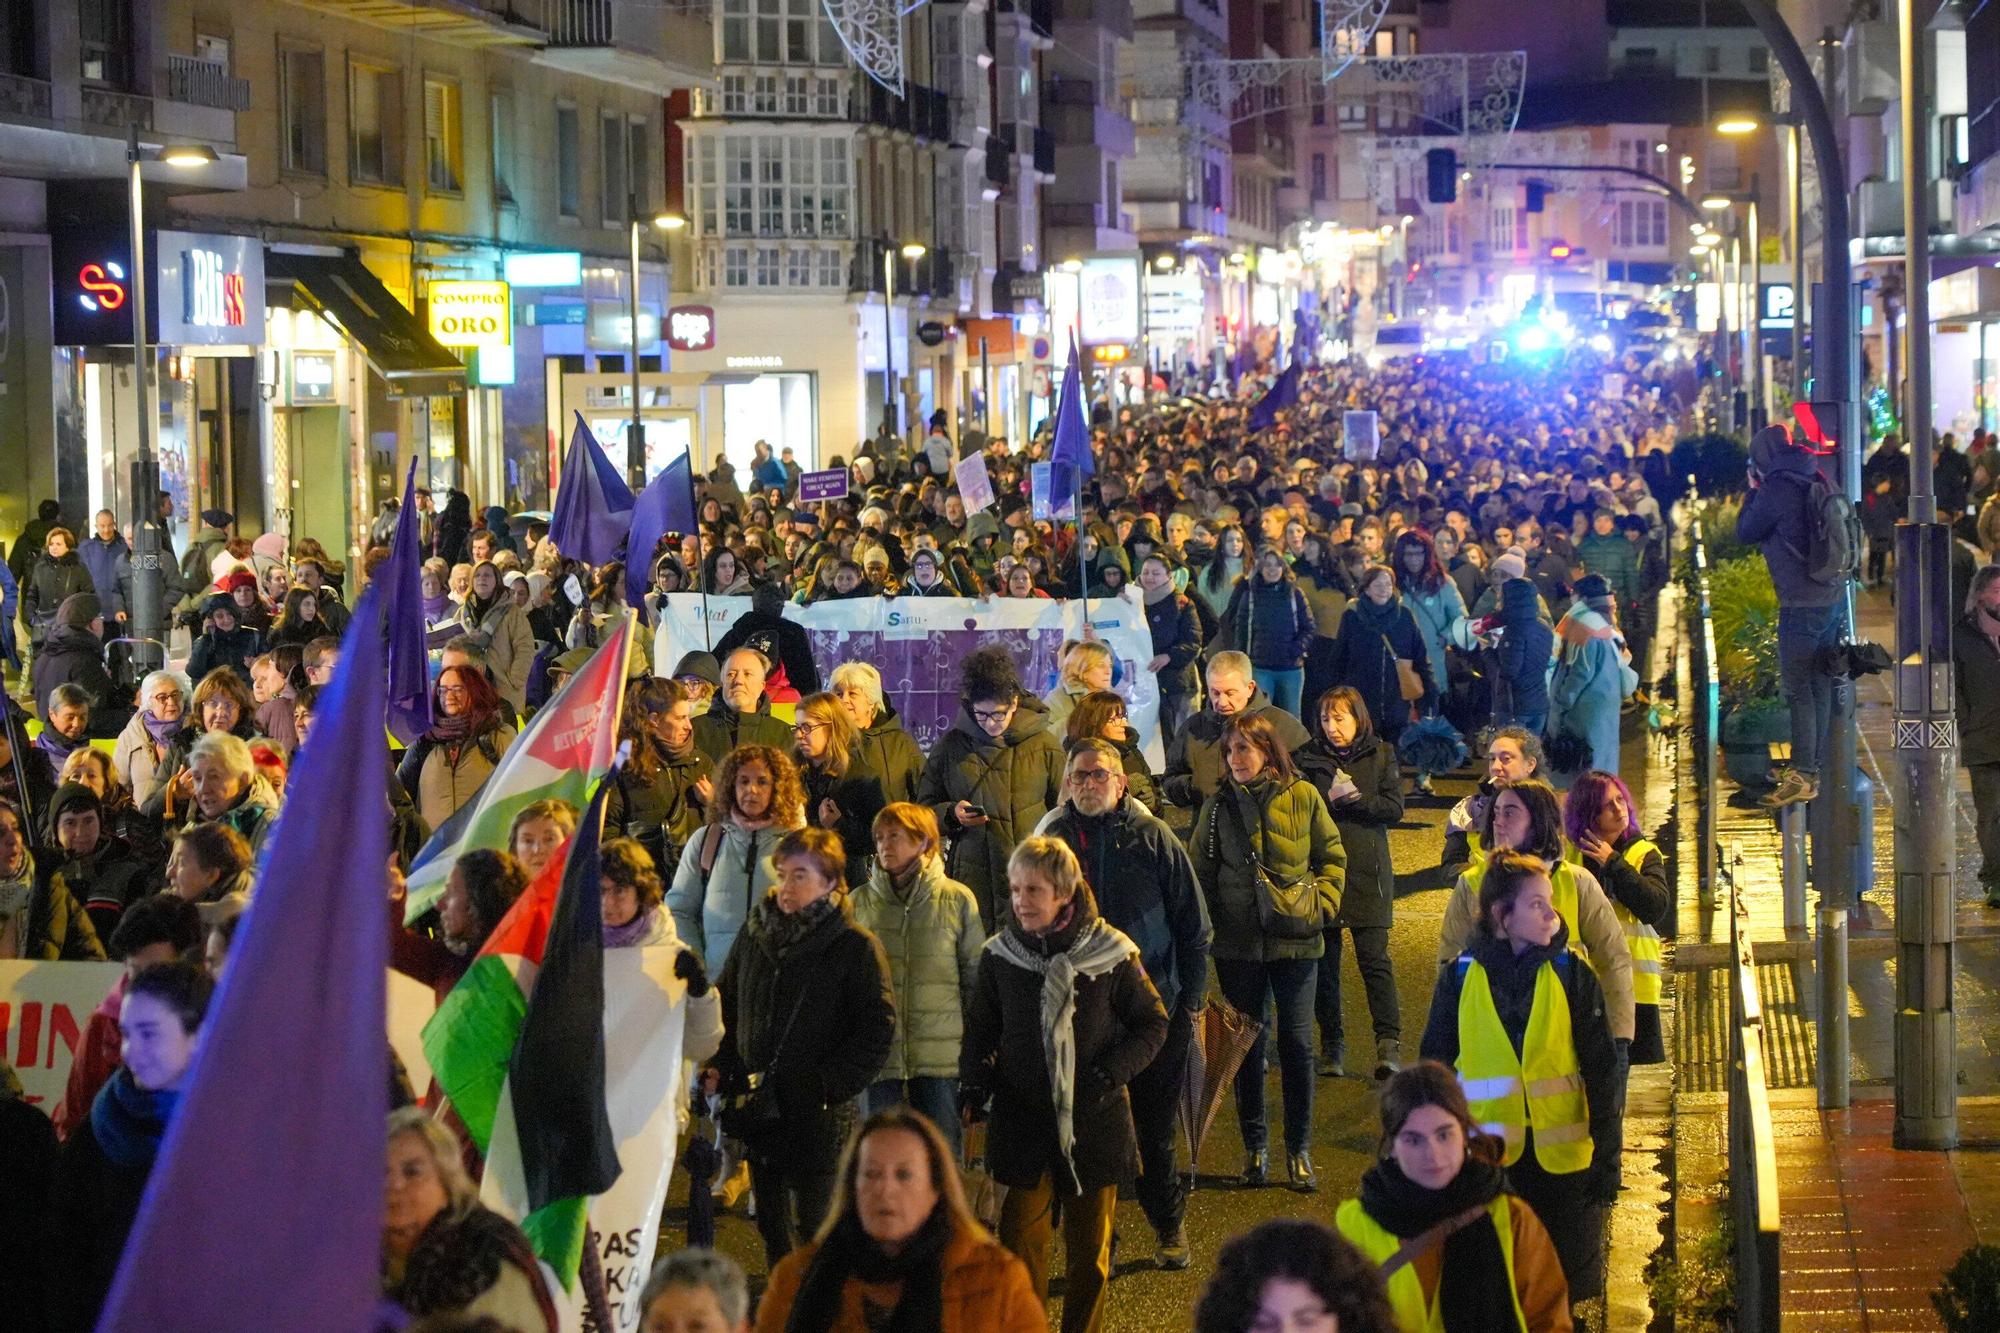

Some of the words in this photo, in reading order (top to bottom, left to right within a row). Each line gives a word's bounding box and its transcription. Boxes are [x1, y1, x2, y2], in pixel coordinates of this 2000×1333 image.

[191, 249, 246, 327] Bliss
[433, 294, 504, 305] COMPRO
[441, 317, 497, 333] ORO
[888, 612, 921, 626] Sartu
